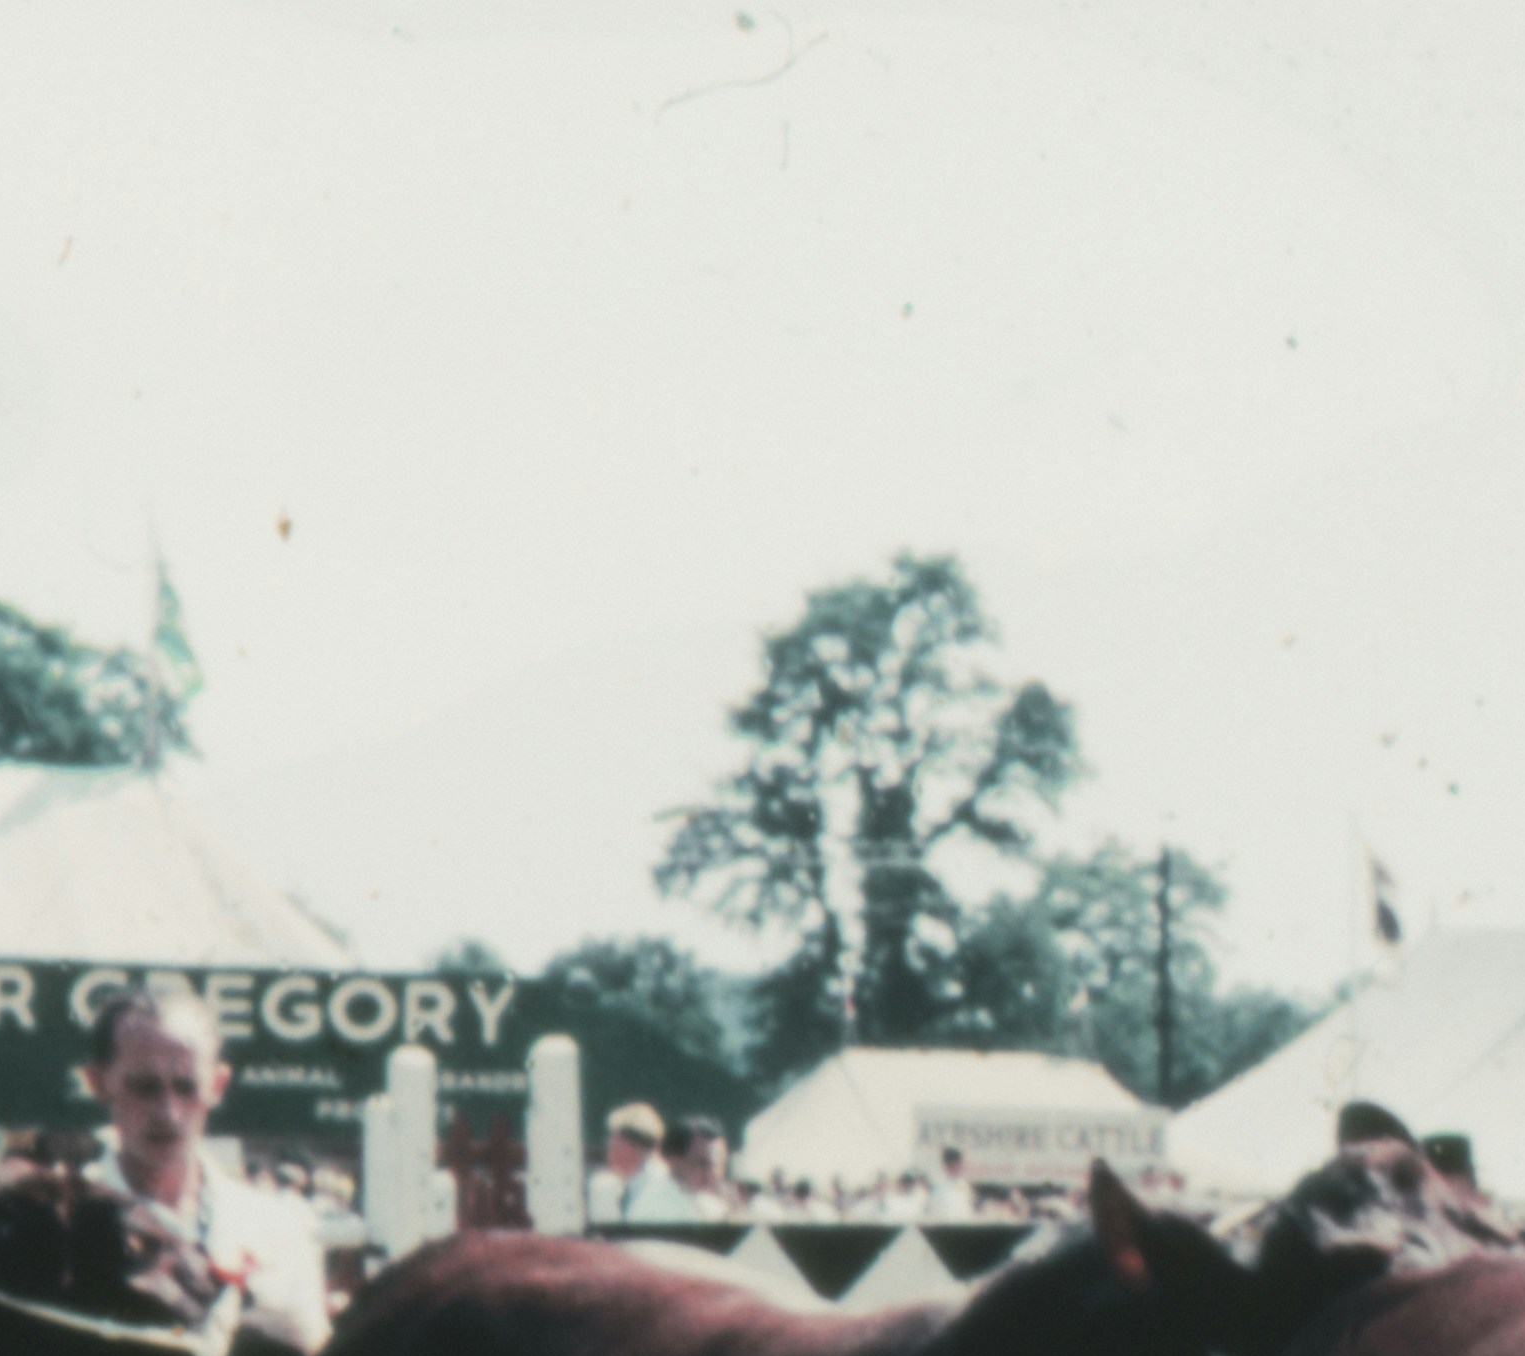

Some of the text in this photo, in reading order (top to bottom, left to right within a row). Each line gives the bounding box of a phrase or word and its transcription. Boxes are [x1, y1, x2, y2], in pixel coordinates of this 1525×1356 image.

[239, 1064, 342, 1091] ANIMAL
[918, 1120, 1166, 1157] AYRSHIRE CATTLE
